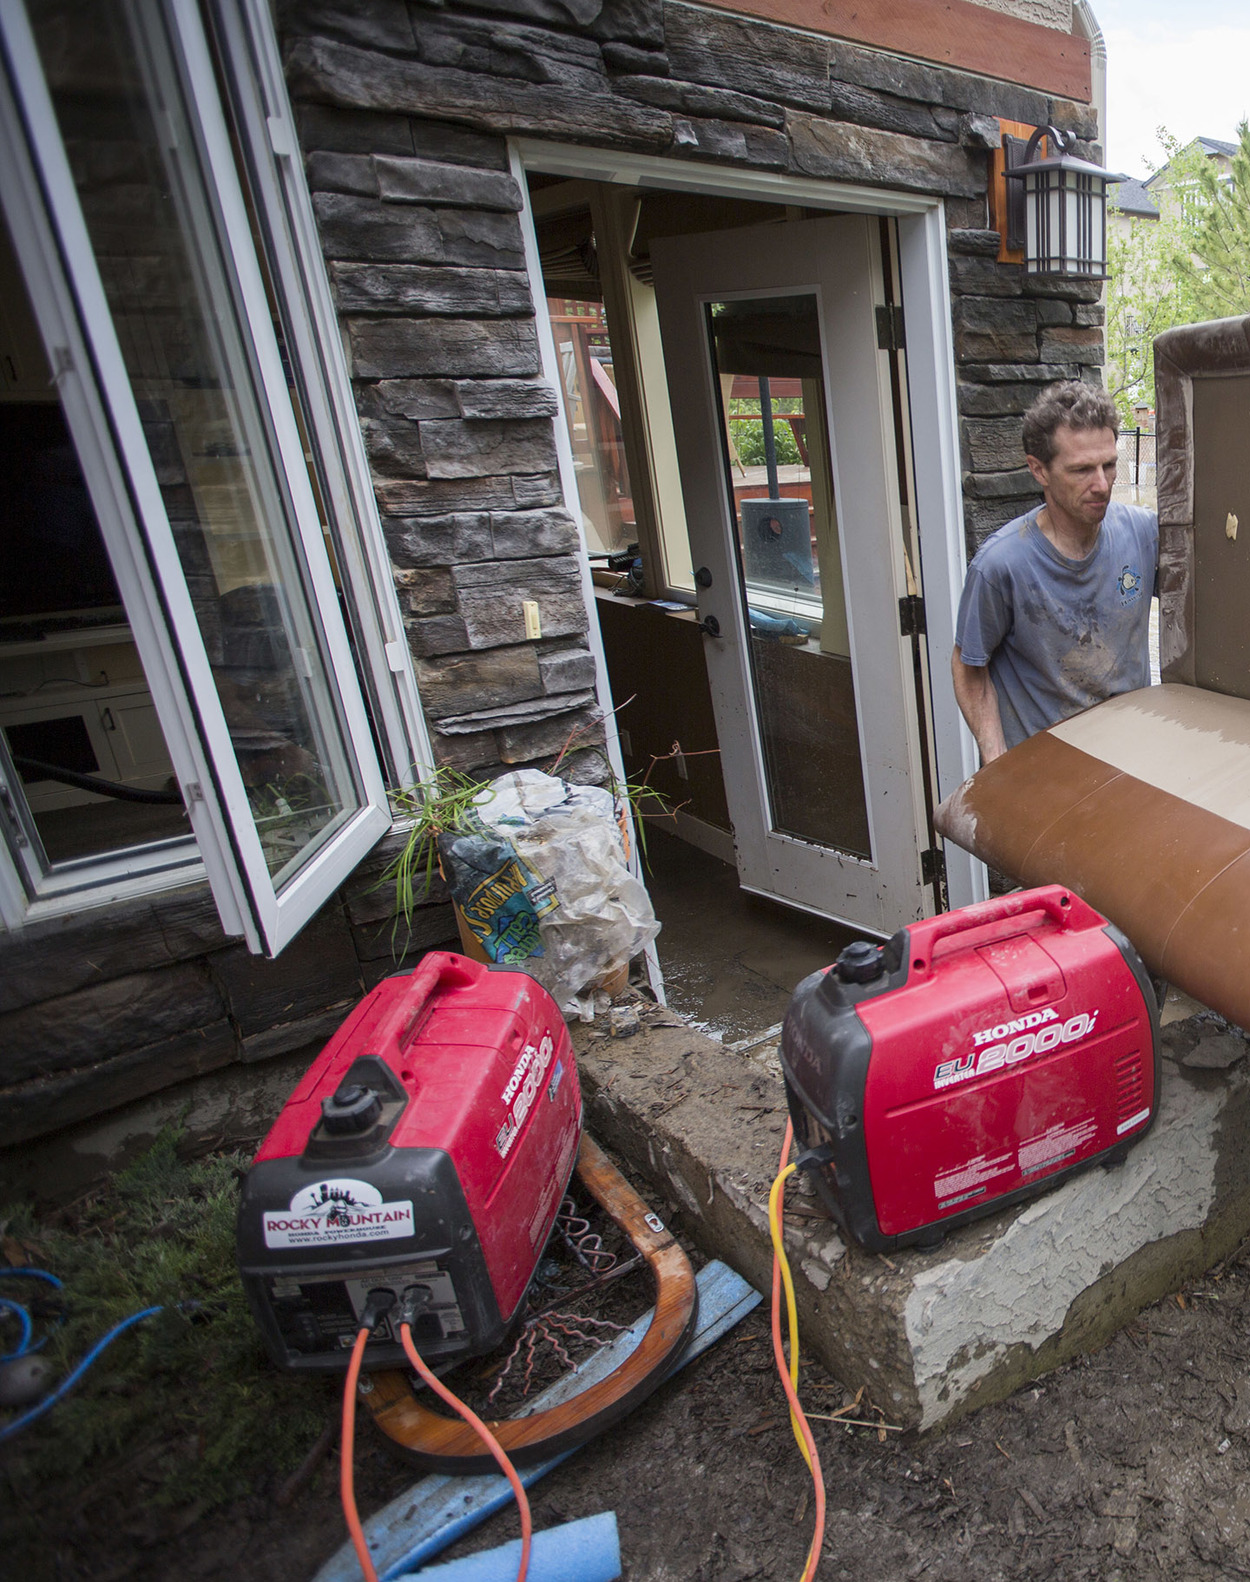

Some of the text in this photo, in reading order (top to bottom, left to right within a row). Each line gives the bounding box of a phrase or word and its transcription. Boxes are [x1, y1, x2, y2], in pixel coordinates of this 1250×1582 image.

[973, 1007, 1059, 1046] HONDA
[501, 1044, 536, 1106] HONDA
[267, 1217, 322, 1232] ROCKY
[324, 1225, 387, 1235] POWERHOUSE
[288, 1229, 389, 1244] www.rockyhonda.com
